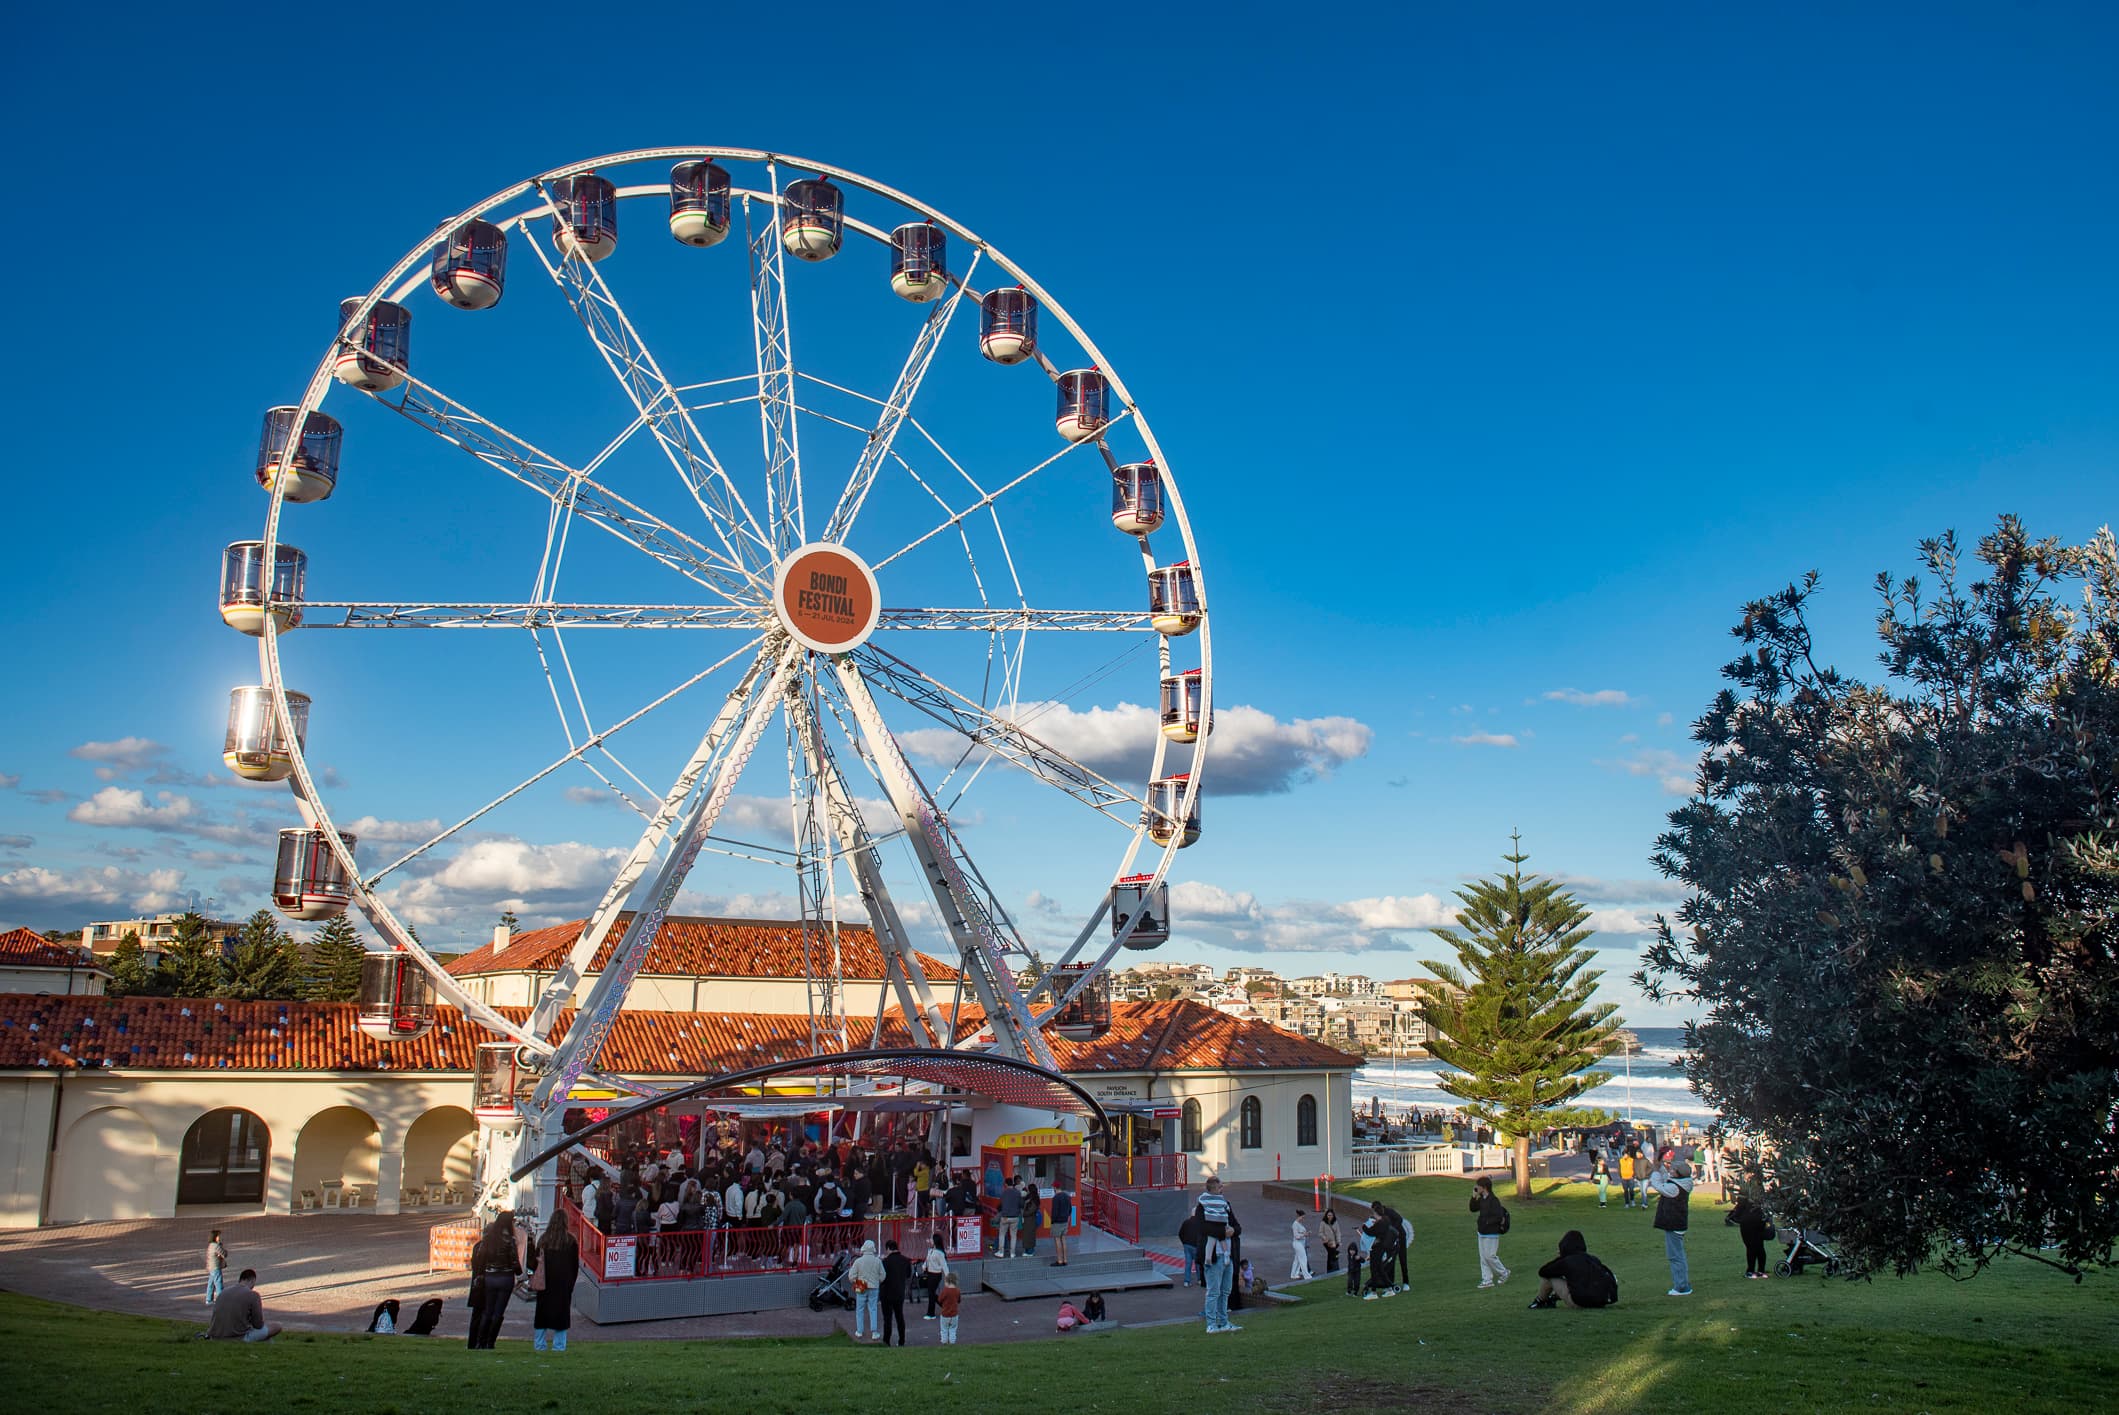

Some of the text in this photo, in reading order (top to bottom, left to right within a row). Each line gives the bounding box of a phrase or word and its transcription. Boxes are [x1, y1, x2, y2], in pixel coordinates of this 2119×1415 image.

[811, 571, 847, 595] BONDI
[799, 590, 855, 617] FESTIVAL
[836, 616, 855, 624] 2024
[1021, 1134, 1069, 1145] TICKETS
[959, 1230, 968, 1240] NO
[608, 1251, 619, 1262] NO
